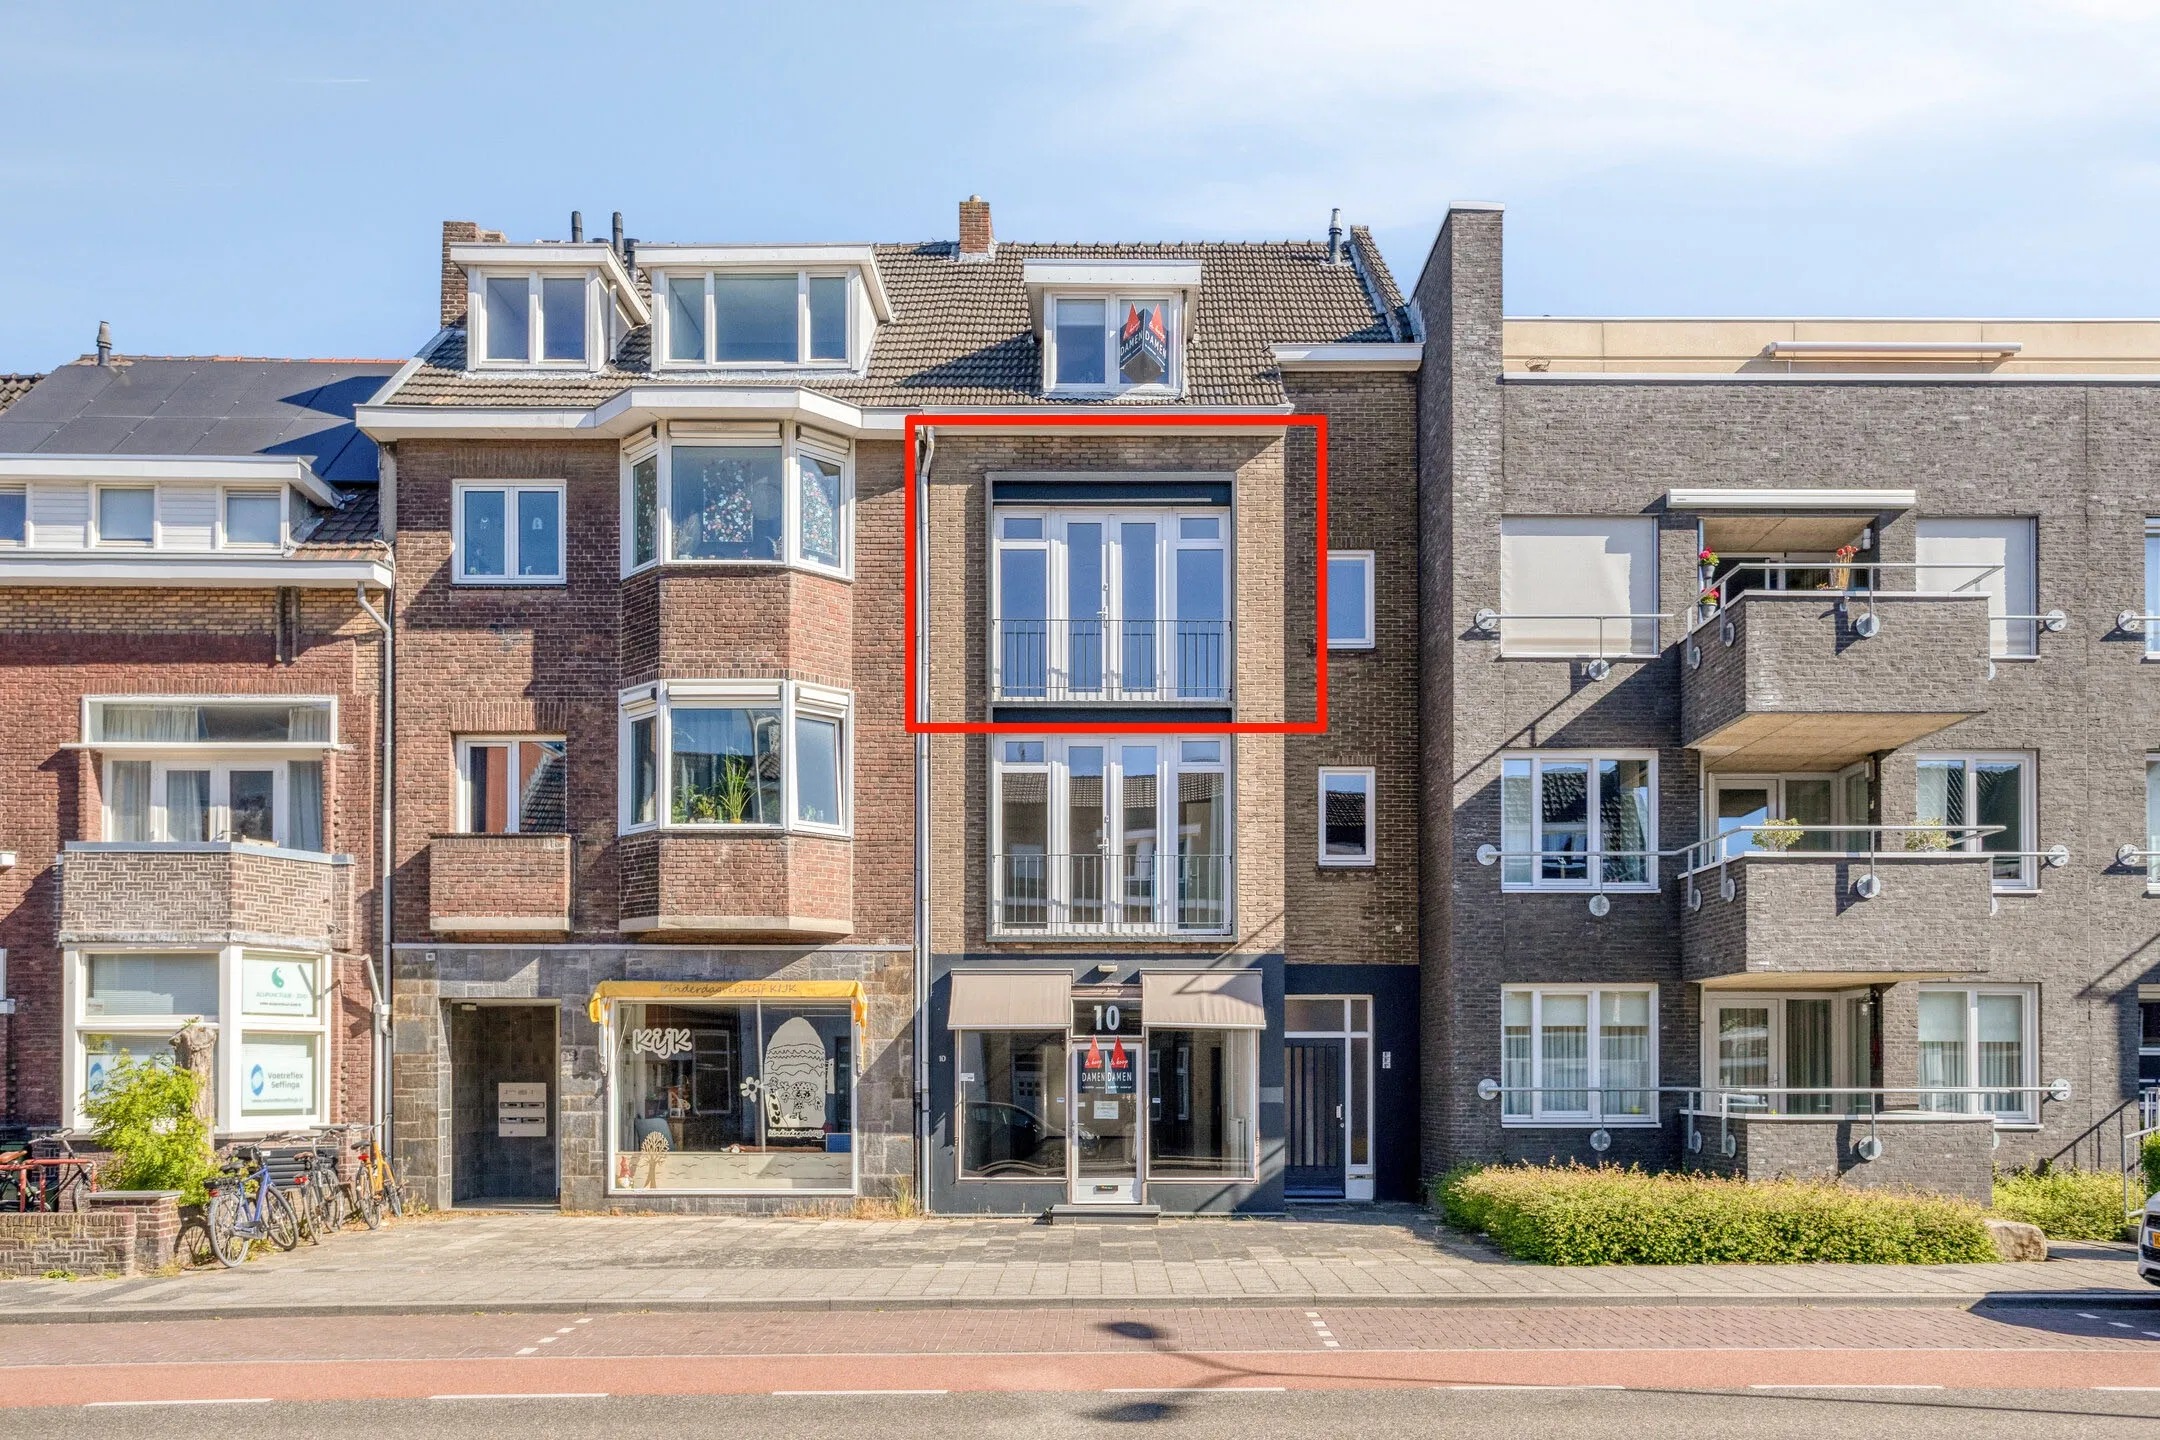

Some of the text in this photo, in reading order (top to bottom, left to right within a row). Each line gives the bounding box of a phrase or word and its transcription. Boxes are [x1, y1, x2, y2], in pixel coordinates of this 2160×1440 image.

[1120, 330, 1143, 356] DAMEN
[1145, 330, 1167, 359] DAMEN
[1093, 1005, 1120, 1031] 10
[1082, 1072, 1105, 1081] DAMEN
[1107, 1072, 1132, 1081] DAMEN
